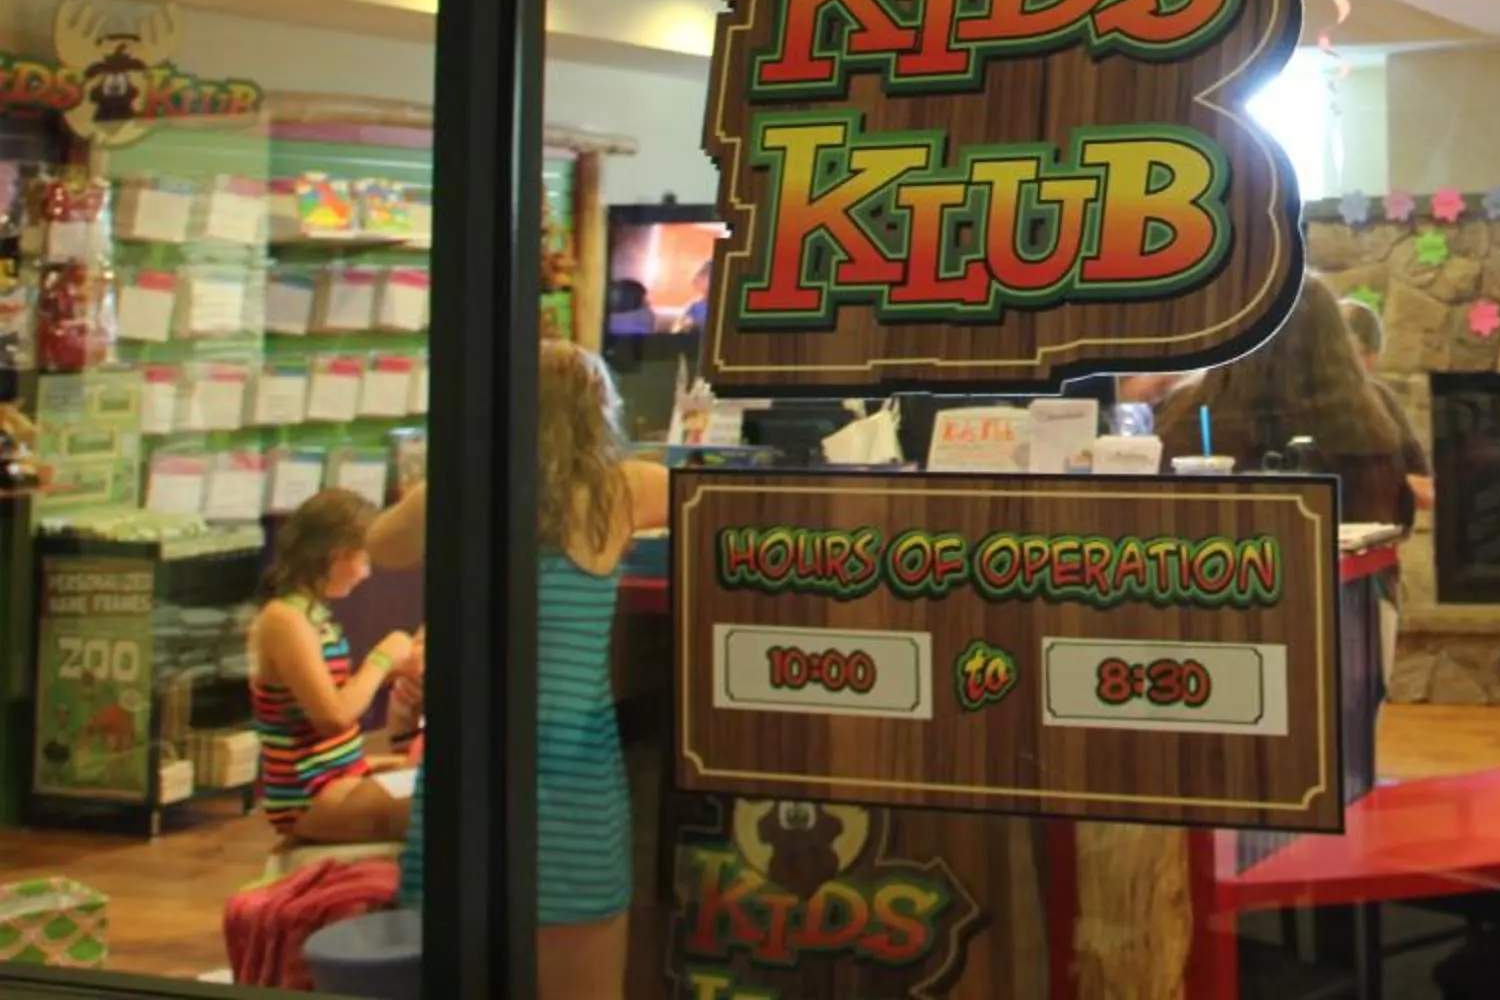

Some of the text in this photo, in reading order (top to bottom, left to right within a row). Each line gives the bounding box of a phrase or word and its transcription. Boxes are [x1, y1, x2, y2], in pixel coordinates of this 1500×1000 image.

[744, 122, 1218, 312] KLUB
[721, 528, 1276, 596] HOURS OF OPERATION
[58, 637, 140, 682] ZOO
[767, 646, 1212, 708] 10:00 to 8:30
[689, 850, 940, 960] KIDS
